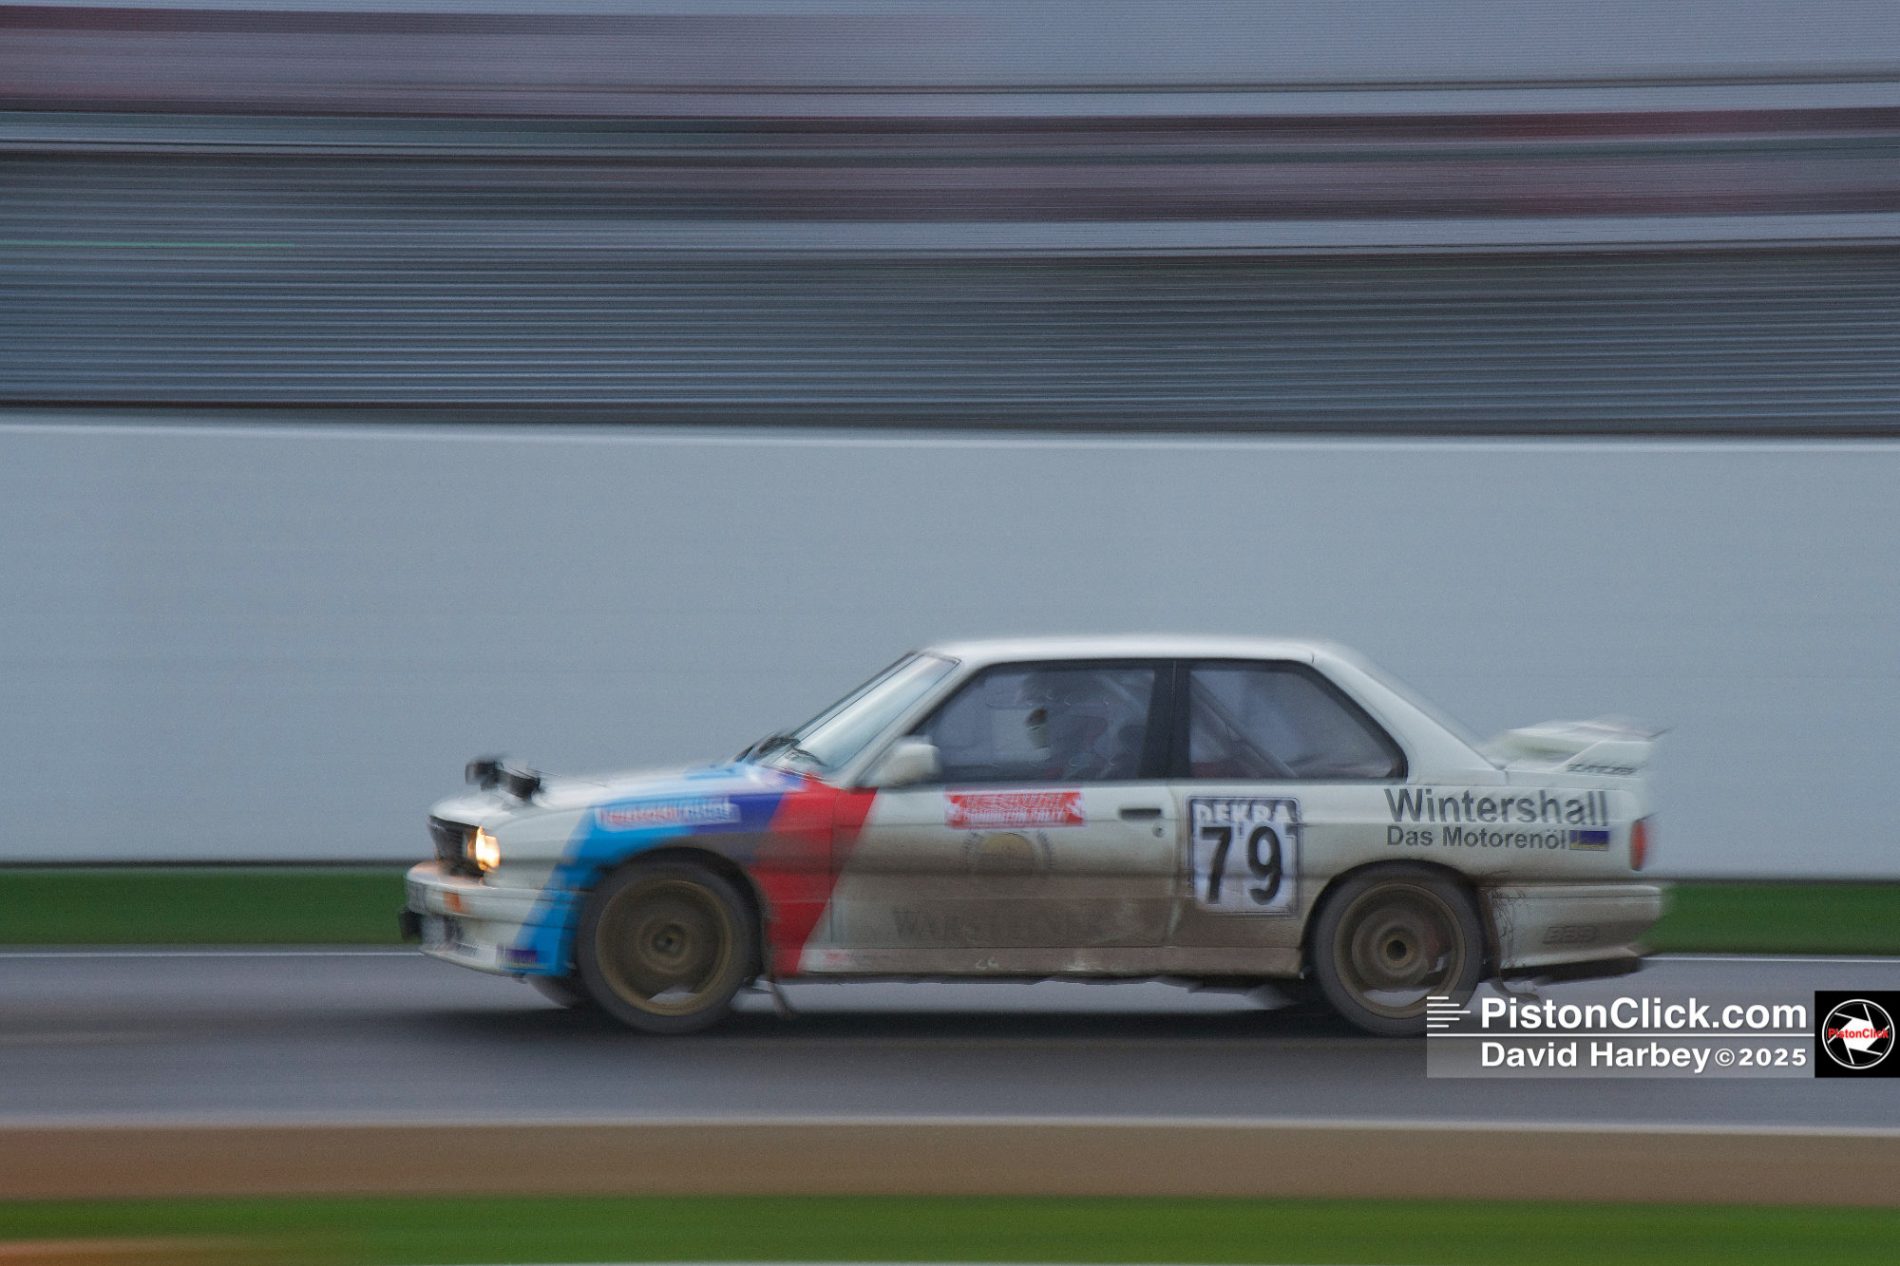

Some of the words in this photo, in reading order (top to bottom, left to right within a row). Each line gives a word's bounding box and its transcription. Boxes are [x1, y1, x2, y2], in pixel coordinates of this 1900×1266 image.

[1192, 803, 1293, 822] DEKRA
[1384, 788, 1608, 826] Wintershall
[1387, 826, 1433, 846] Das
[1443, 827, 1566, 850] Motorenöl
[1200, 826, 1283, 906] 79
